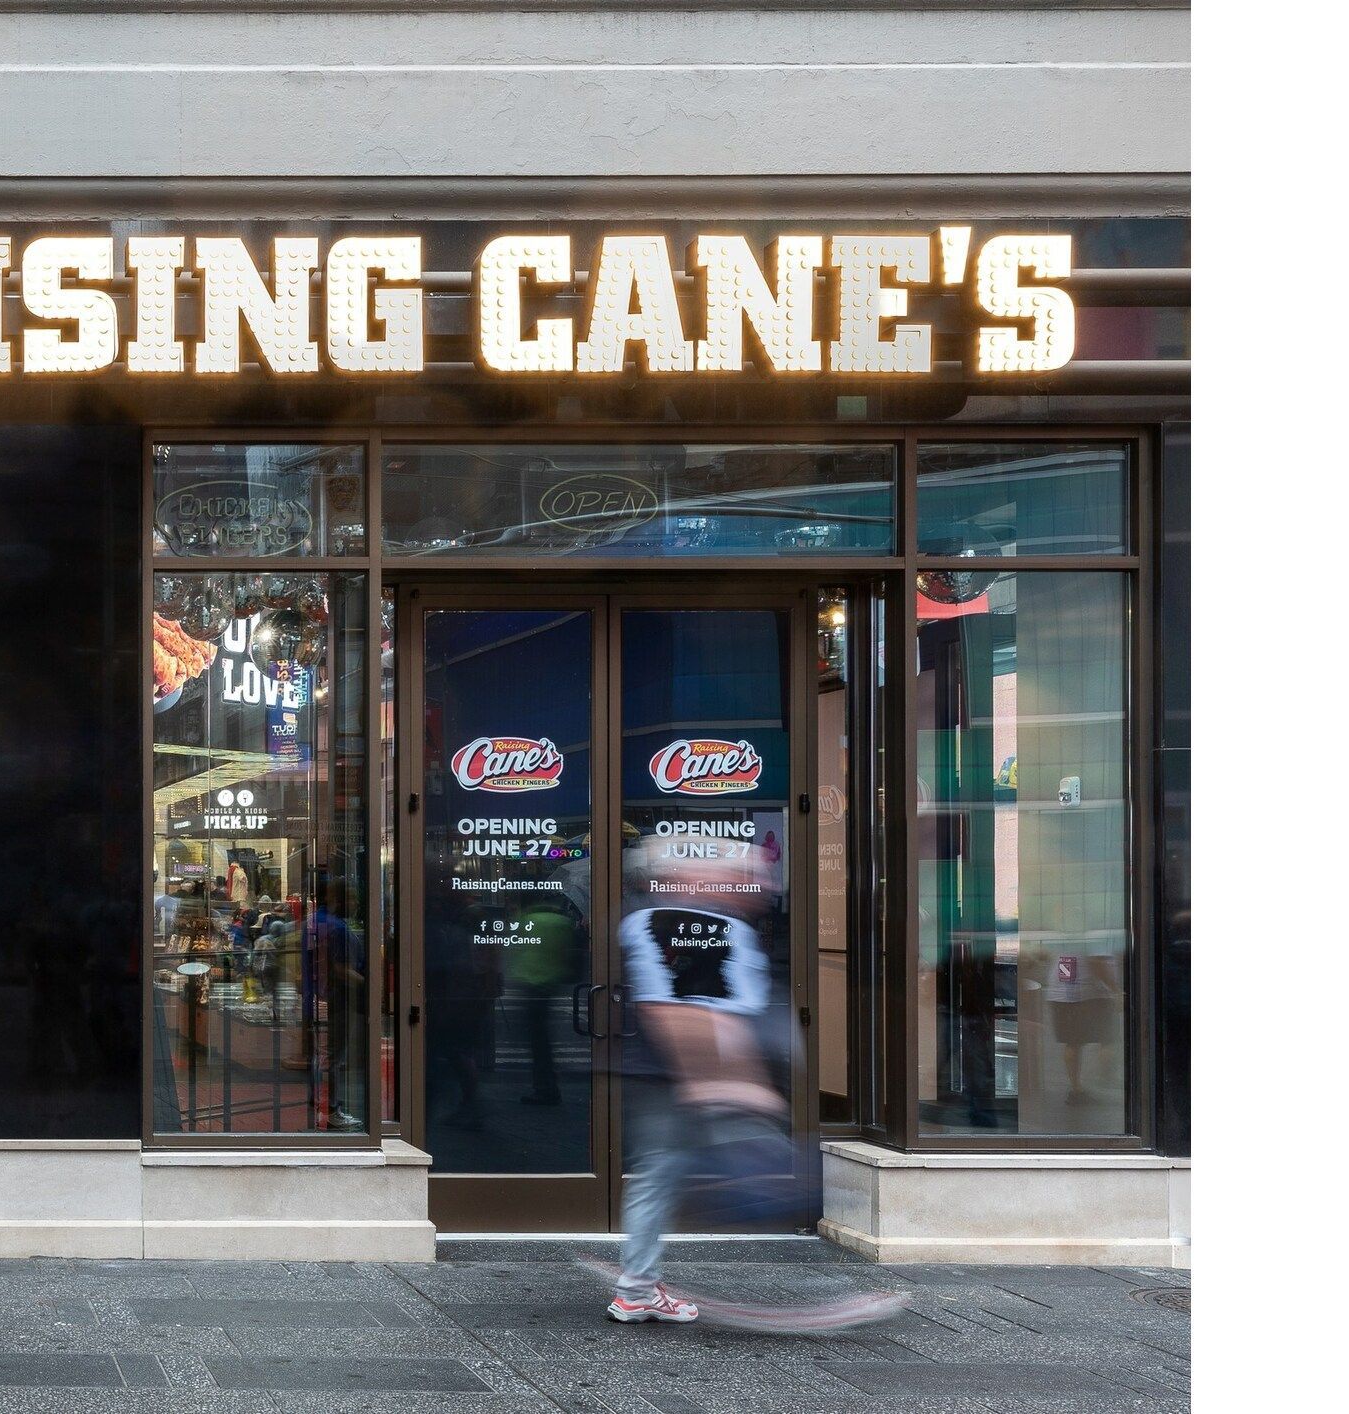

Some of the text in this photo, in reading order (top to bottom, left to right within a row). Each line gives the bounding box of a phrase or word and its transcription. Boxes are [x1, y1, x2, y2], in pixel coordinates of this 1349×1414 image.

[476, 226, 1076, 374] CANE'S
[551, 489, 647, 519] OPEN
[221, 658, 300, 708] LOVE
[494, 739, 531, 753] Raising
[692, 742, 729, 755] Raising
[456, 737, 564, 788] Cane's
[654, 739, 762, 791] Cane's
[491, 778, 550, 786] CHICKEN FINGERS
[689, 780, 749, 789] CHICKEN FINGERS
[204, 816, 242, 830] PICK
[246, 816, 268, 829] UP
[457, 818, 557, 835] OPENING
[655, 820, 756, 838] OPENING
[462, 839, 552, 856] JUNE 27
[661, 841, 751, 859] JUNE 27
[451, 877, 563, 893] RaisingCanes.com
[649, 880, 762, 896] RaisingCanes.com
[473, 935, 542, 948] RaisingCanes
